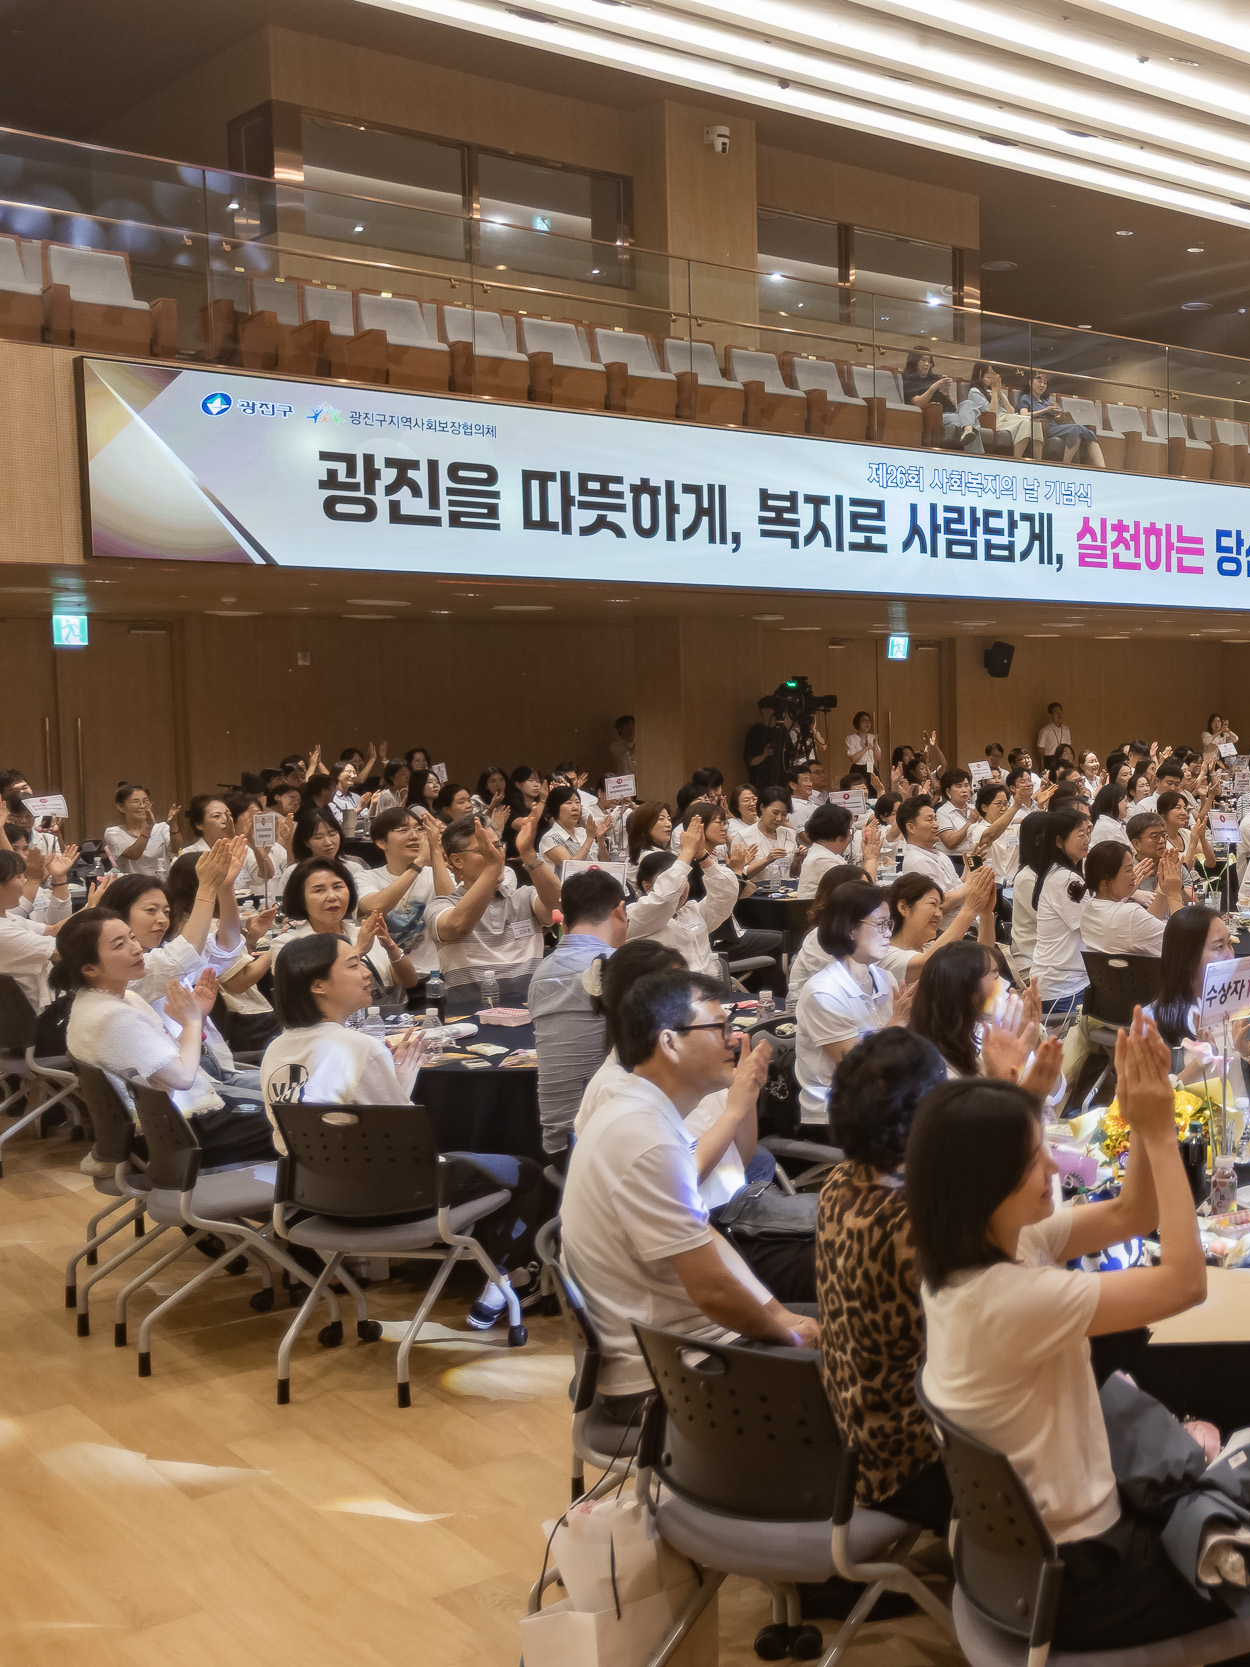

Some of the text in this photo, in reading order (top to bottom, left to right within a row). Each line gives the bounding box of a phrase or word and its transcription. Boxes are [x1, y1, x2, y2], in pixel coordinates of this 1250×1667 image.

[237, 399, 294, 418] 광진구
[349, 409, 498, 439] 광진구지역사회보장협의체
[867, 462, 1093, 507] 제26회 사회복지의 날 기념식
[318, 450, 501, 532] 광진을
[521, 469, 742, 554] 따뜻하게,
[758, 488, 888, 554] 복지로
[902, 502, 1064, 572] 사람답게,
[1076, 516, 1205, 575] 실천하는
